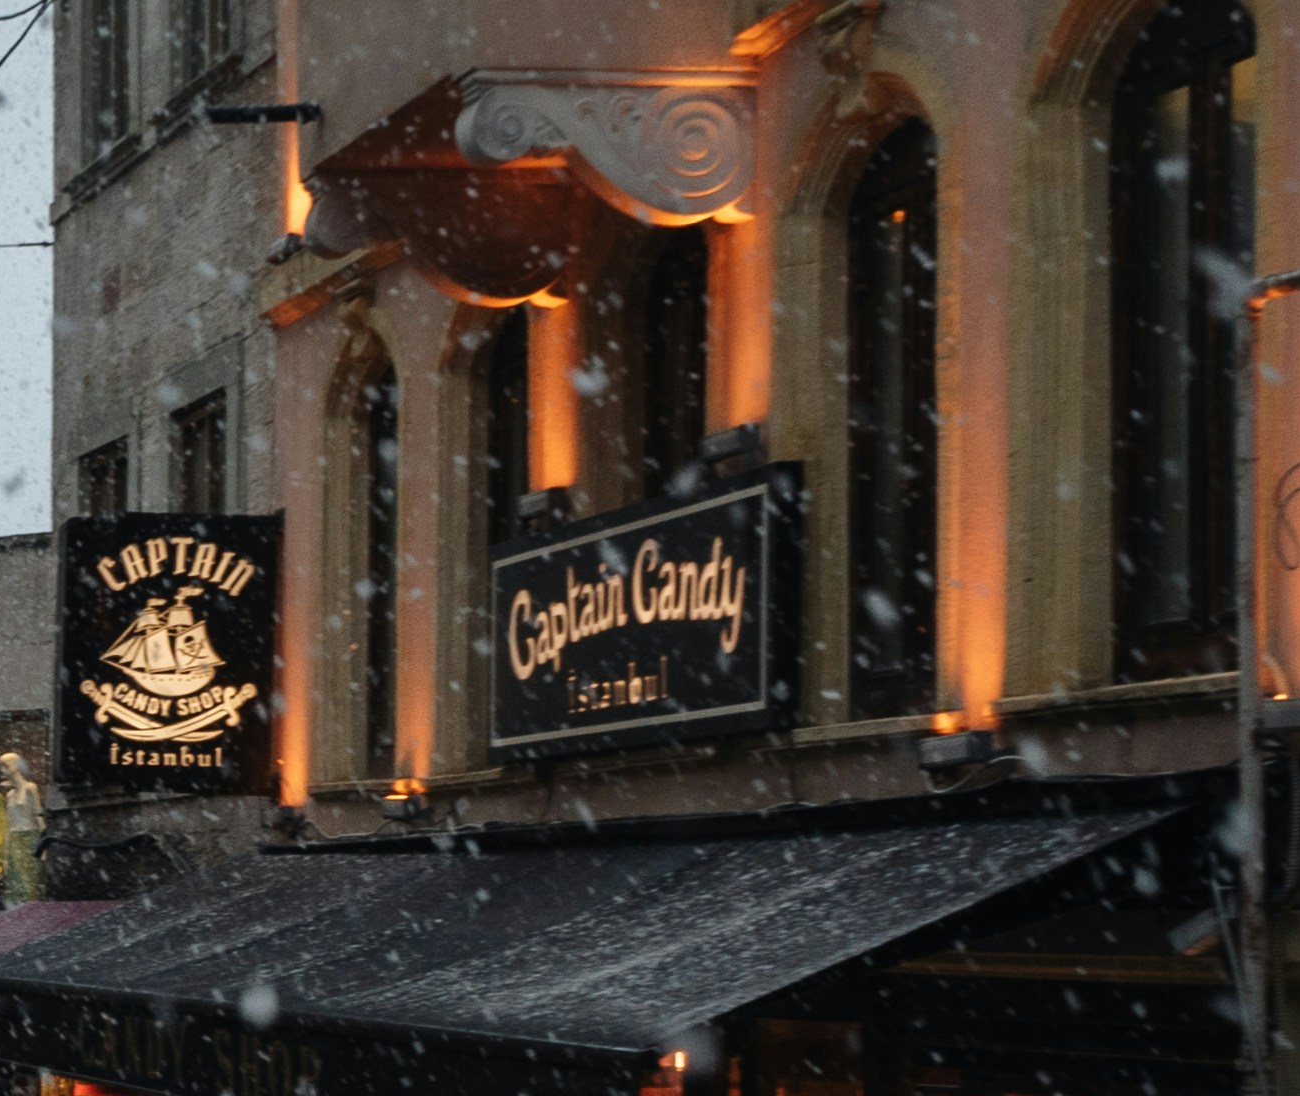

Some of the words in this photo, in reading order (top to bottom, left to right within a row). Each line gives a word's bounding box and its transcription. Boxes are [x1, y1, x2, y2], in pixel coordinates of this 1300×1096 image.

[96, 535, 256, 597] CAPTAIN
[508, 563, 629, 681] Captain
[632, 535, 746, 654] Candy
[113, 682, 172, 717] CANDY
[177, 686, 225, 716] SHOP
